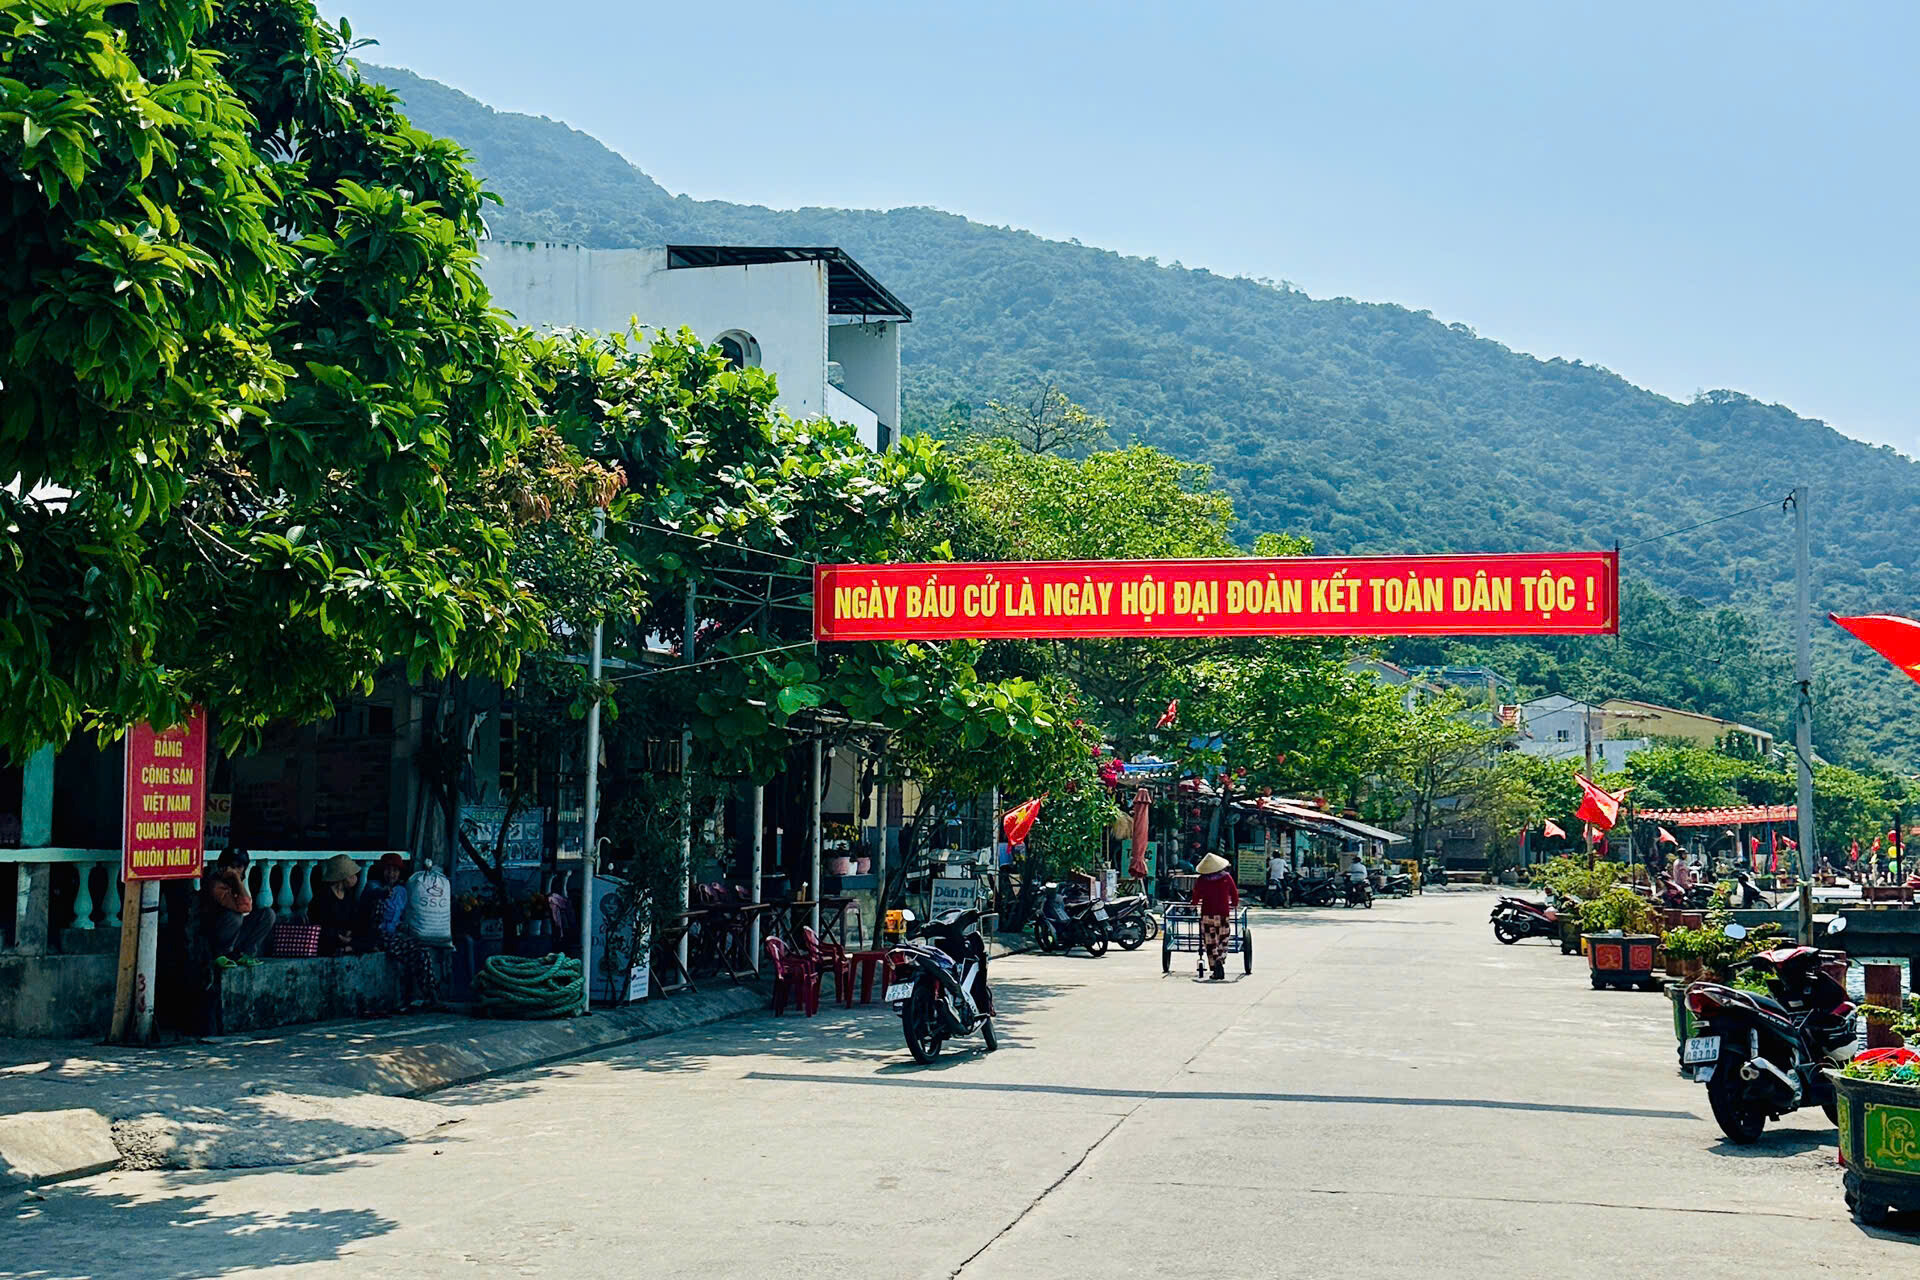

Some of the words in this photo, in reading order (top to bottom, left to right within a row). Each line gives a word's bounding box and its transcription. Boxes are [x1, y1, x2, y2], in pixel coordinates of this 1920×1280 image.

[834, 580, 898, 620] NGÀY
[906, 574, 956, 618] BẦU
[963, 573, 1000, 617] CỬ
[1005, 577, 1036, 617] LÀ
[1043, 576, 1113, 616] NGÀY
[1121, 574, 1165, 622] HỘI
[1173, 580, 1218, 622] ĐẠI
[1226, 573, 1302, 613] ĐOÀN
[1311, 568, 1362, 613] KẾT
[1369, 571, 1444, 612] TOÀN
[1453, 569, 1512, 611] DÂN
[1520, 569, 1576, 619] TỘC
[1586, 576, 1594, 611] !
[154, 735, 183, 758] ĐẢNG
[141, 764, 170, 788] CỘNG
[172, 763, 193, 785] SẢN
[143, 791, 165, 815] VIỆT
[167, 795, 191, 812] NAM
[136, 822, 170, 841] QUANG
[172, 821, 197, 839] VINH
[133, 846, 164, 867] MUÔN
[167, 846, 190, 866] NĂM
[193, 848, 197, 865] !
